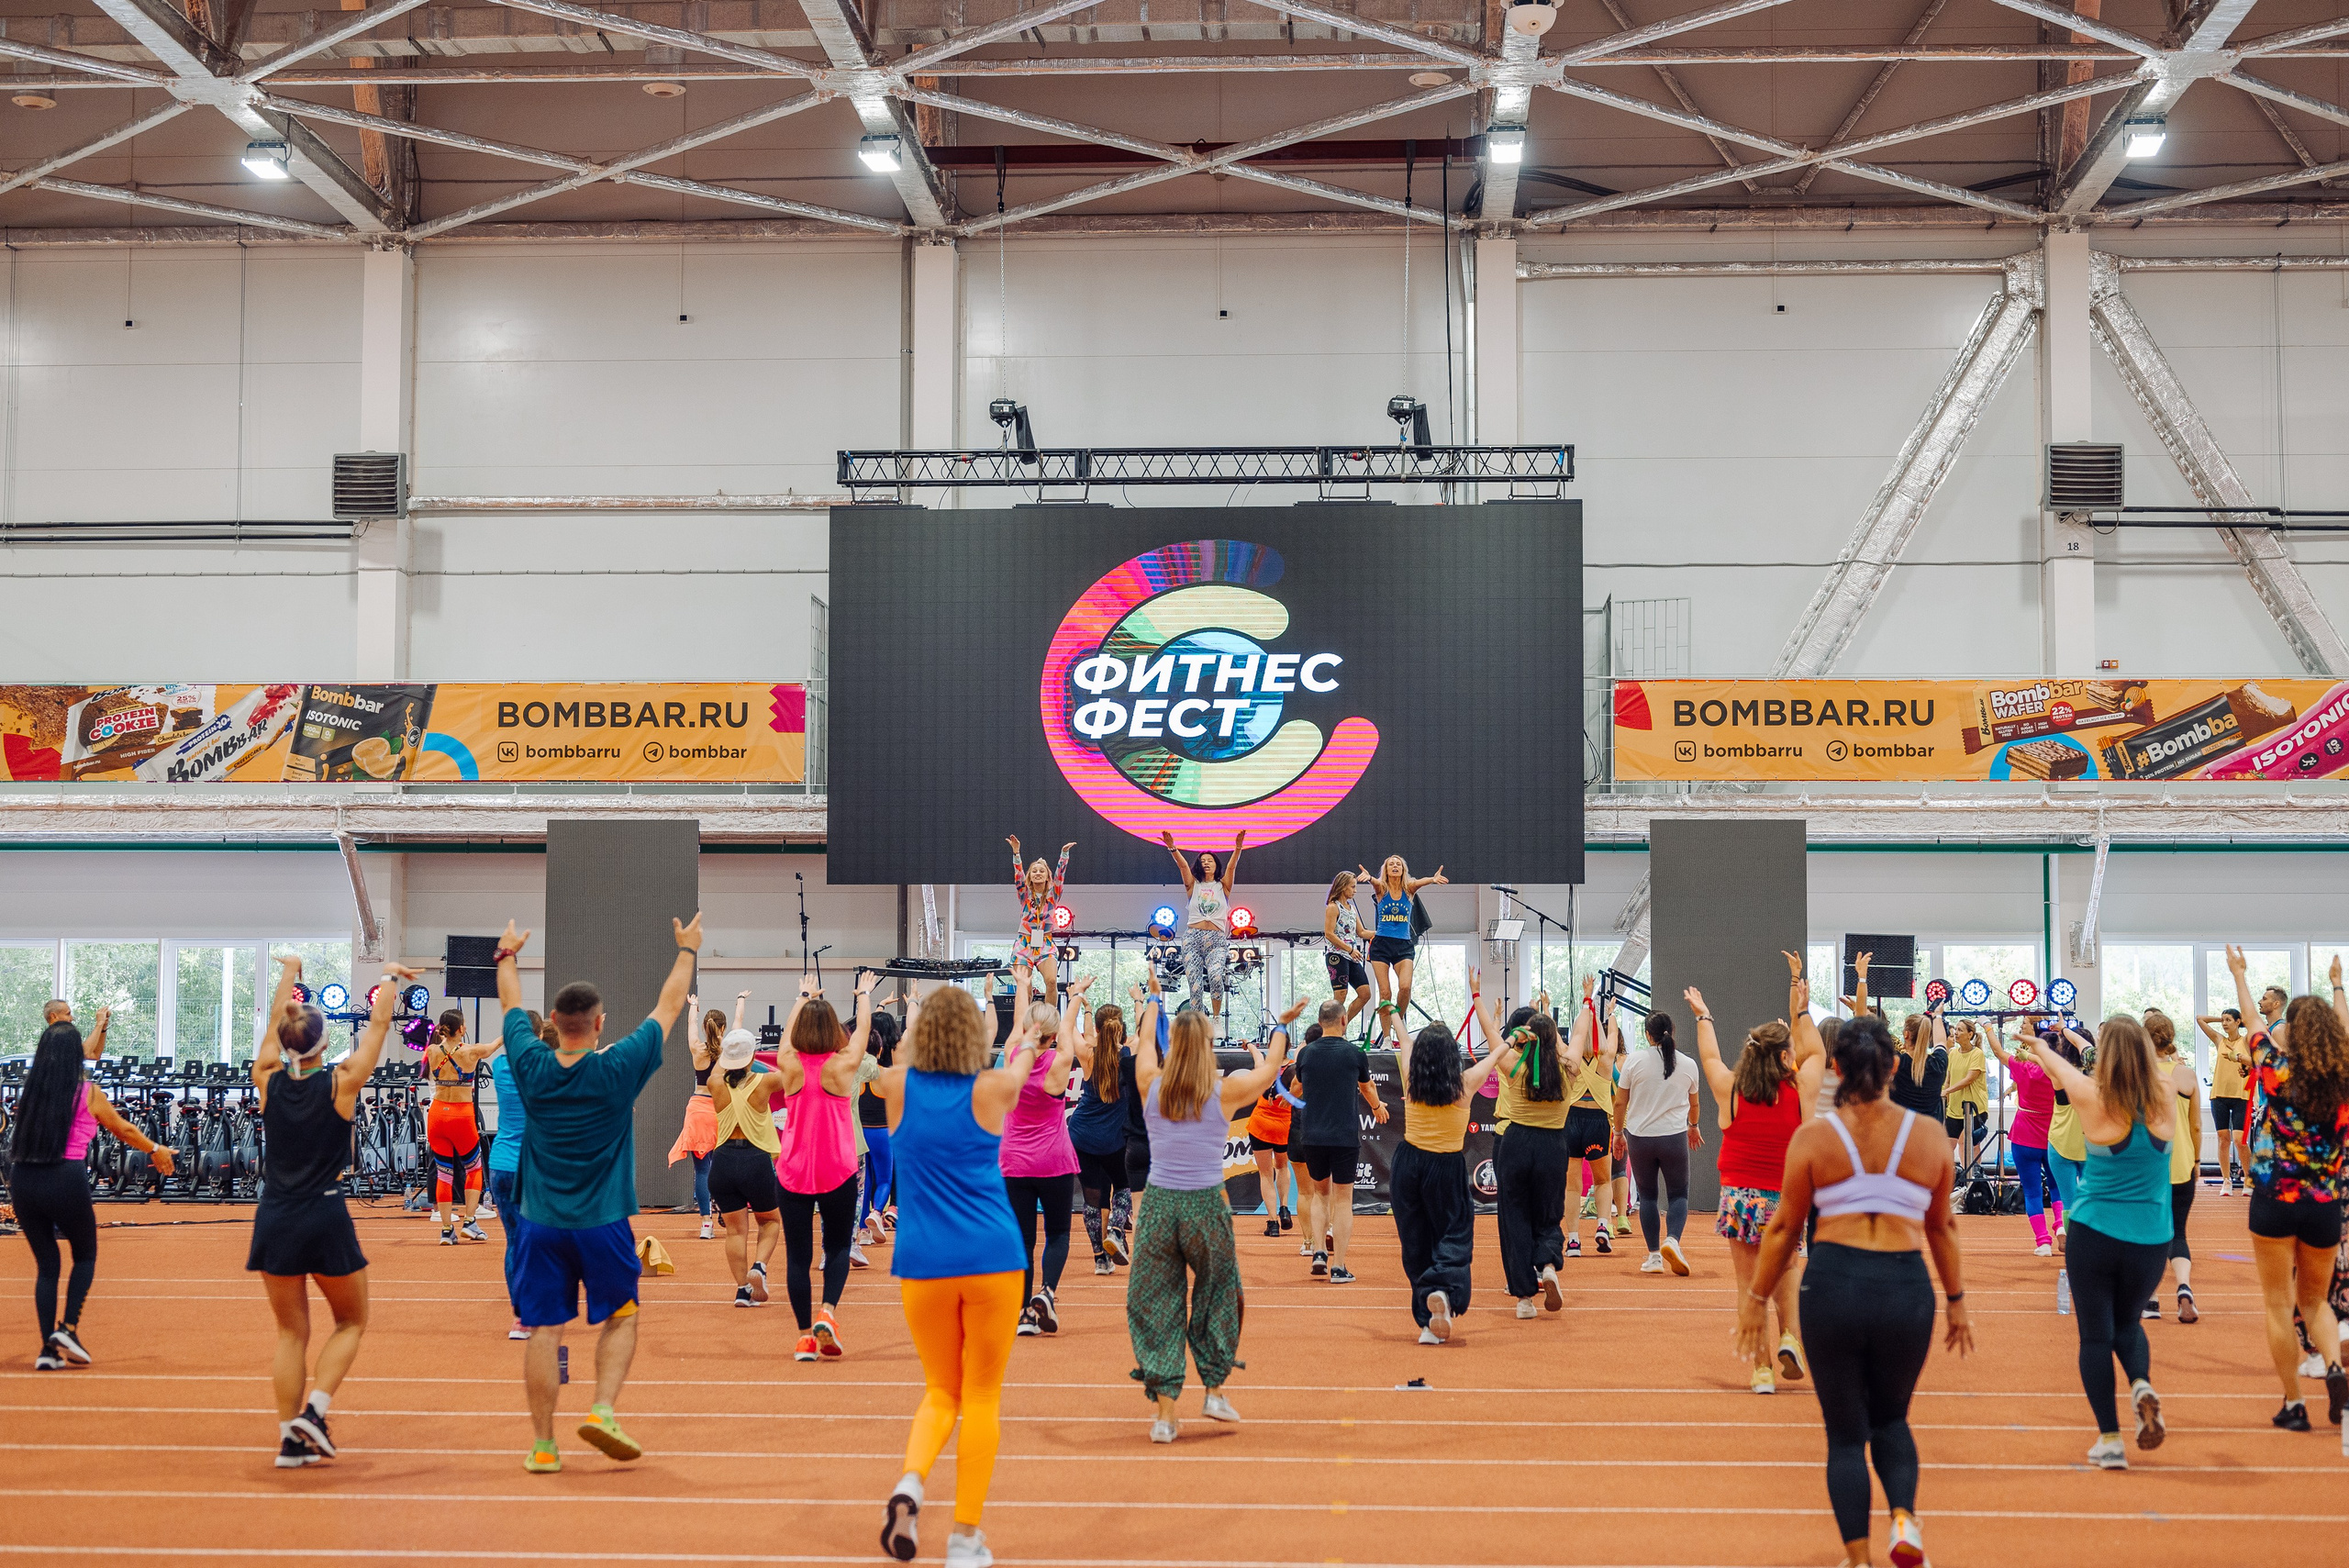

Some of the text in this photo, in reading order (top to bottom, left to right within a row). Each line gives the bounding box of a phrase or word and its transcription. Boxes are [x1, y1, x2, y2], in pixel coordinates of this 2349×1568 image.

[2067, 542, 2079, 551] 18
[1073, 652, 1344, 695] ФИТНЕС
[311, 685, 384, 714] Bombbar
[1991, 682, 2082, 706] Bombbar
[96, 707, 155, 728] PROTEIN
[306, 709, 362, 731] ISOTONIC
[497, 701, 749, 728] BOMBBAR.RU
[1073, 697, 1252, 740] ФЕСТ
[1674, 699, 1935, 727] BOMBBAR.RU
[1994, 701, 2044, 718] WAFER
[2052, 706, 2073, 716] 22%
[90, 717, 157, 740] COOKIE
[188, 726, 217, 748] PROTEIN
[167, 718, 268, 782] BOMBBAR
[186, 736, 221, 762] natural bar
[233, 746, 262, 768] CHEESECAKE
[526, 744, 621, 759] bombbarru
[669, 744, 748, 759] bombbar
[1704, 743, 1803, 758] bombbarru
[1853, 743, 1934, 758] bombbar
[2185, 751, 2202, 761] SUGAR
[73, 760, 101, 770] bombbar.ru
[2154, 763, 2175, 774] PROTEIN
[1585, 1144, 1604, 1155] ZUMBA
